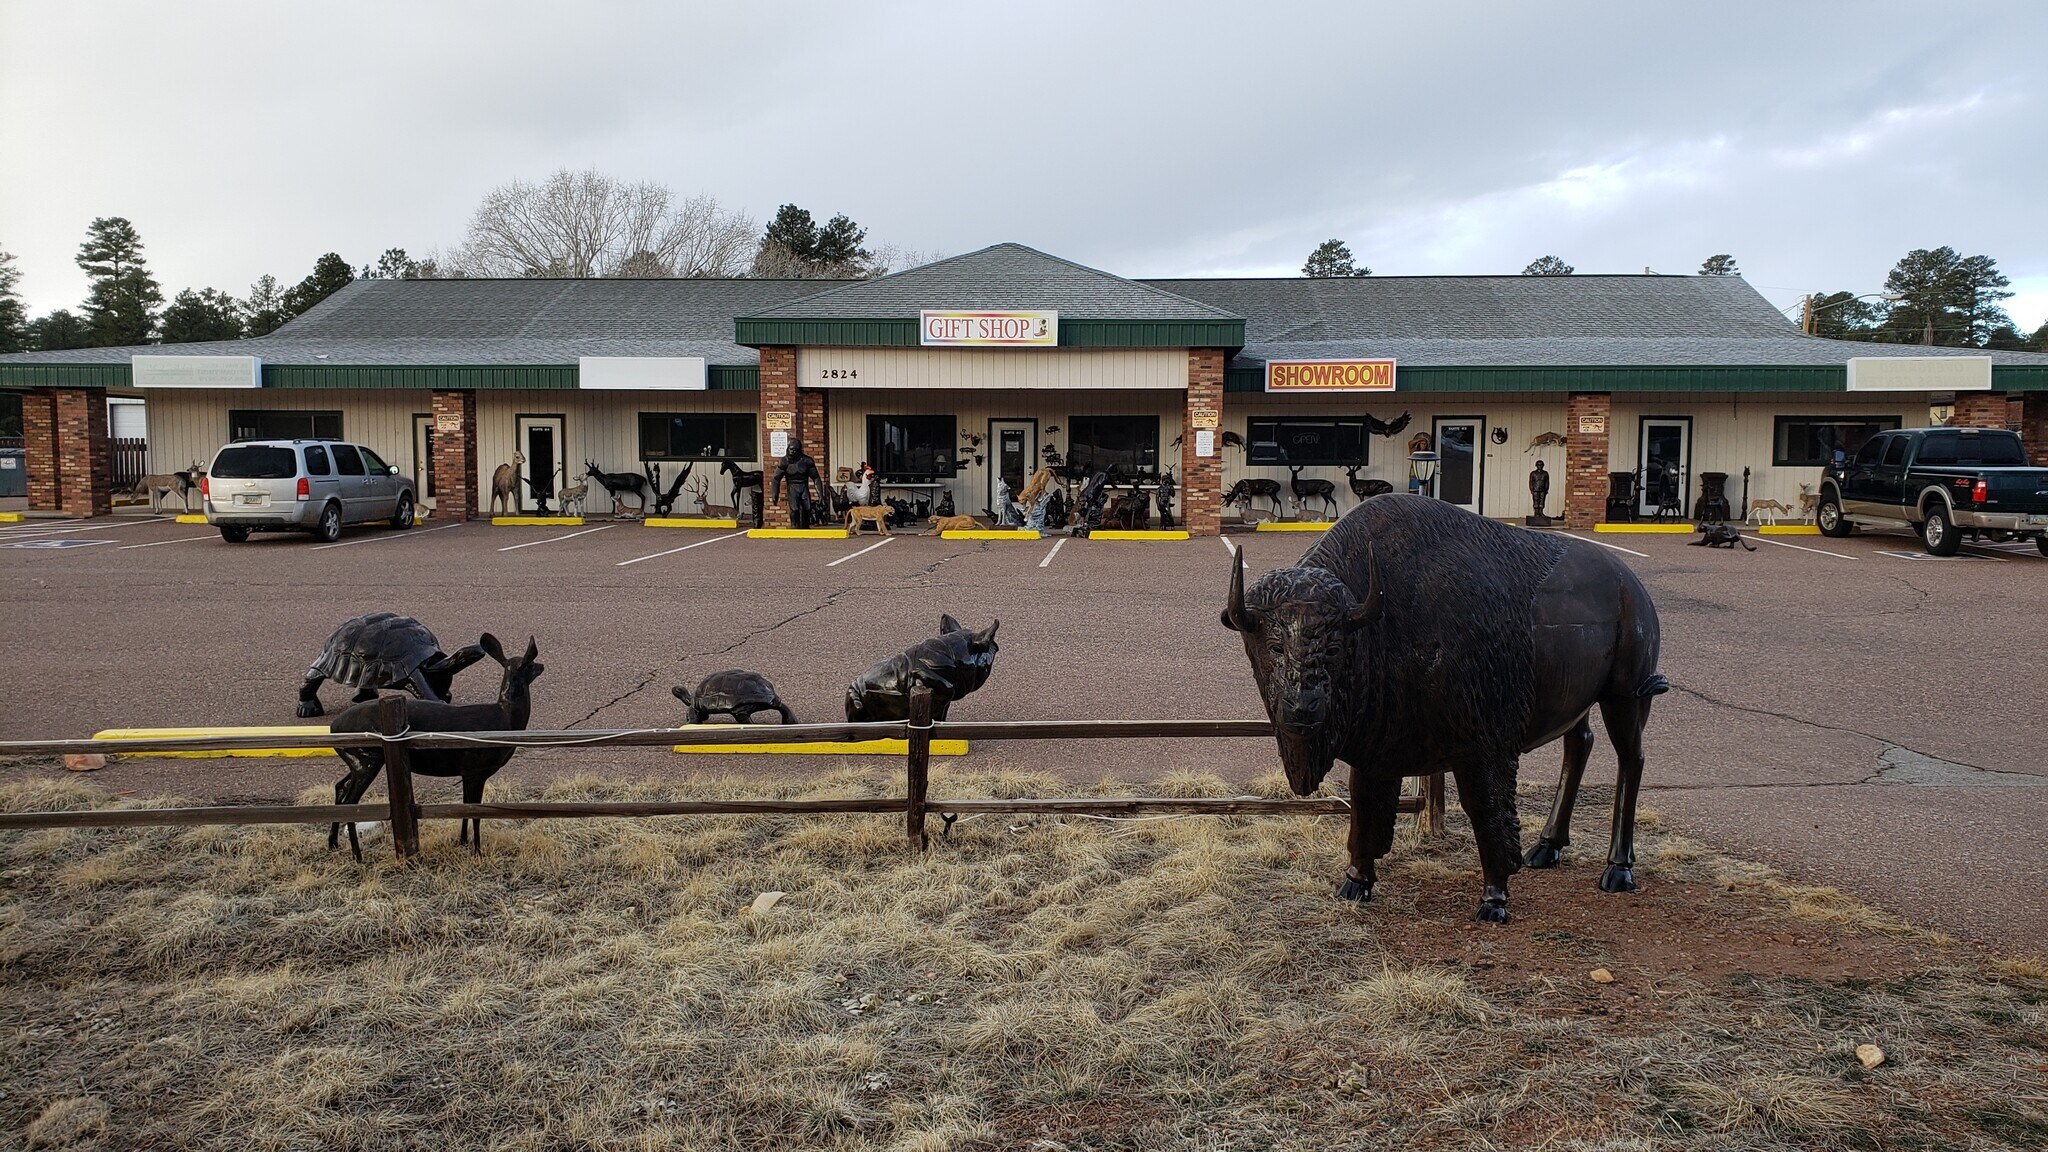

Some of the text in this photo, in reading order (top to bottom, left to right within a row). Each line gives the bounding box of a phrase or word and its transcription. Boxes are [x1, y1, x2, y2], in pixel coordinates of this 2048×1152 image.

[929, 318, 1030, 339] GIFT SHOP
[822, 369, 858, 379] 2824
[1273, 365, 1389, 386] SHOWROOM
[1293, 434, 1319, 444] OPEN
